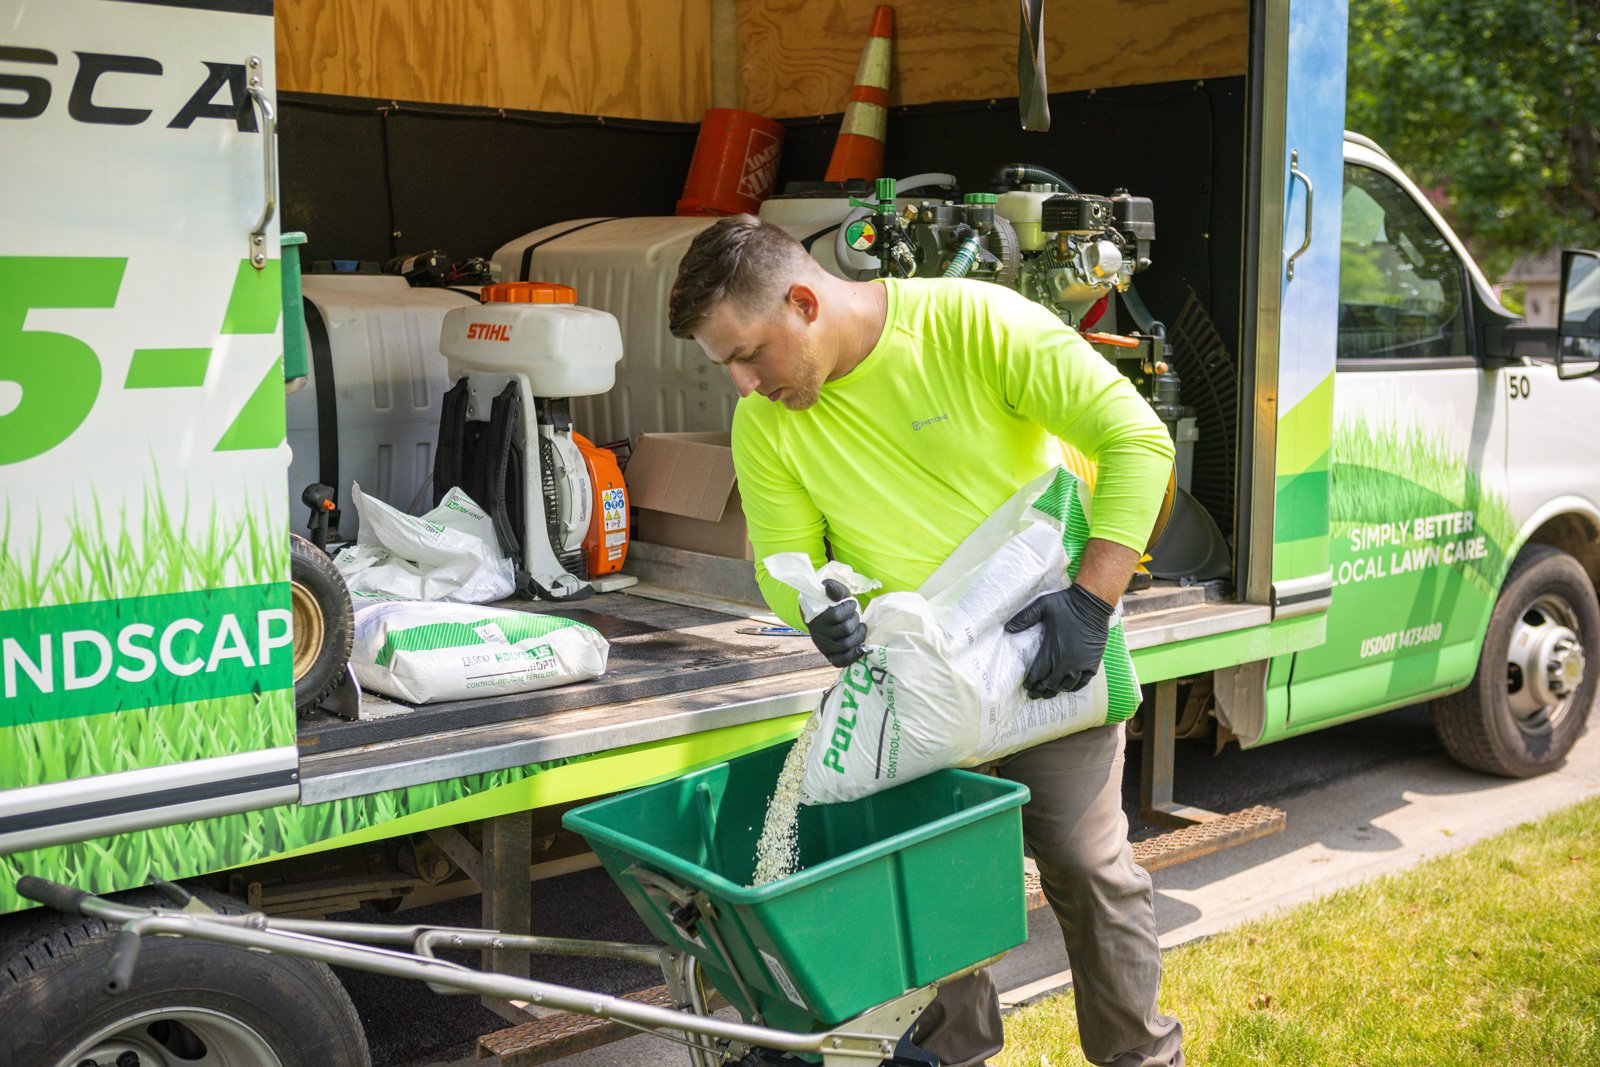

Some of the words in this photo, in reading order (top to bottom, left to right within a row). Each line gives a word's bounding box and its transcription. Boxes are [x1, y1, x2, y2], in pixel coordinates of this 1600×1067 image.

[467, 323, 511, 342] STIHL
[1509, 375, 1530, 399] 50
[1351, 520, 1410, 552] SIMPLY
[1414, 511, 1474, 541] BETTER
[1329, 554, 1387, 587] LOCAL
[1391, 545, 1441, 575] LAWN
[1443, 536, 1489, 565] CARE.
[1360, 632, 1398, 658] USDOT
[823, 655, 874, 775] POLYP
